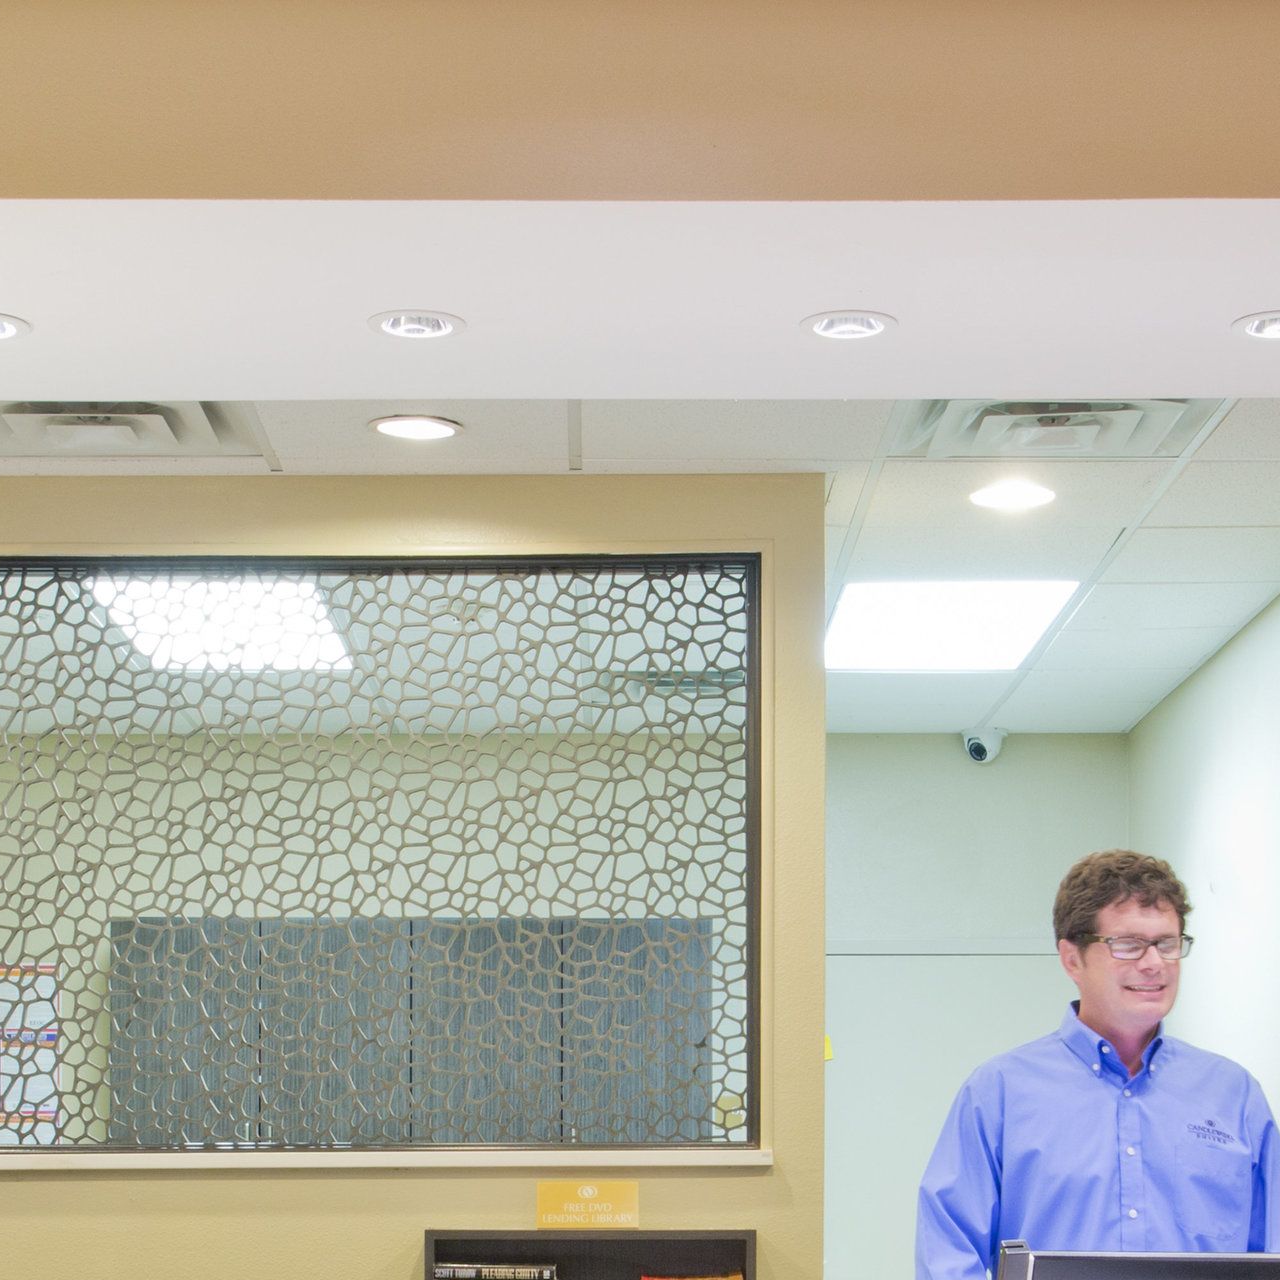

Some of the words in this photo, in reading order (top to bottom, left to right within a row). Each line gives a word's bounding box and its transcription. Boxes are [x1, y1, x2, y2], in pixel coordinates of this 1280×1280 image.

[564, 1202, 586, 1212] FREE
[589, 1202, 612, 1212] DVD
[543, 1214, 588, 1224] LENDING
[591, 1213, 633, 1224] LIBRARY
